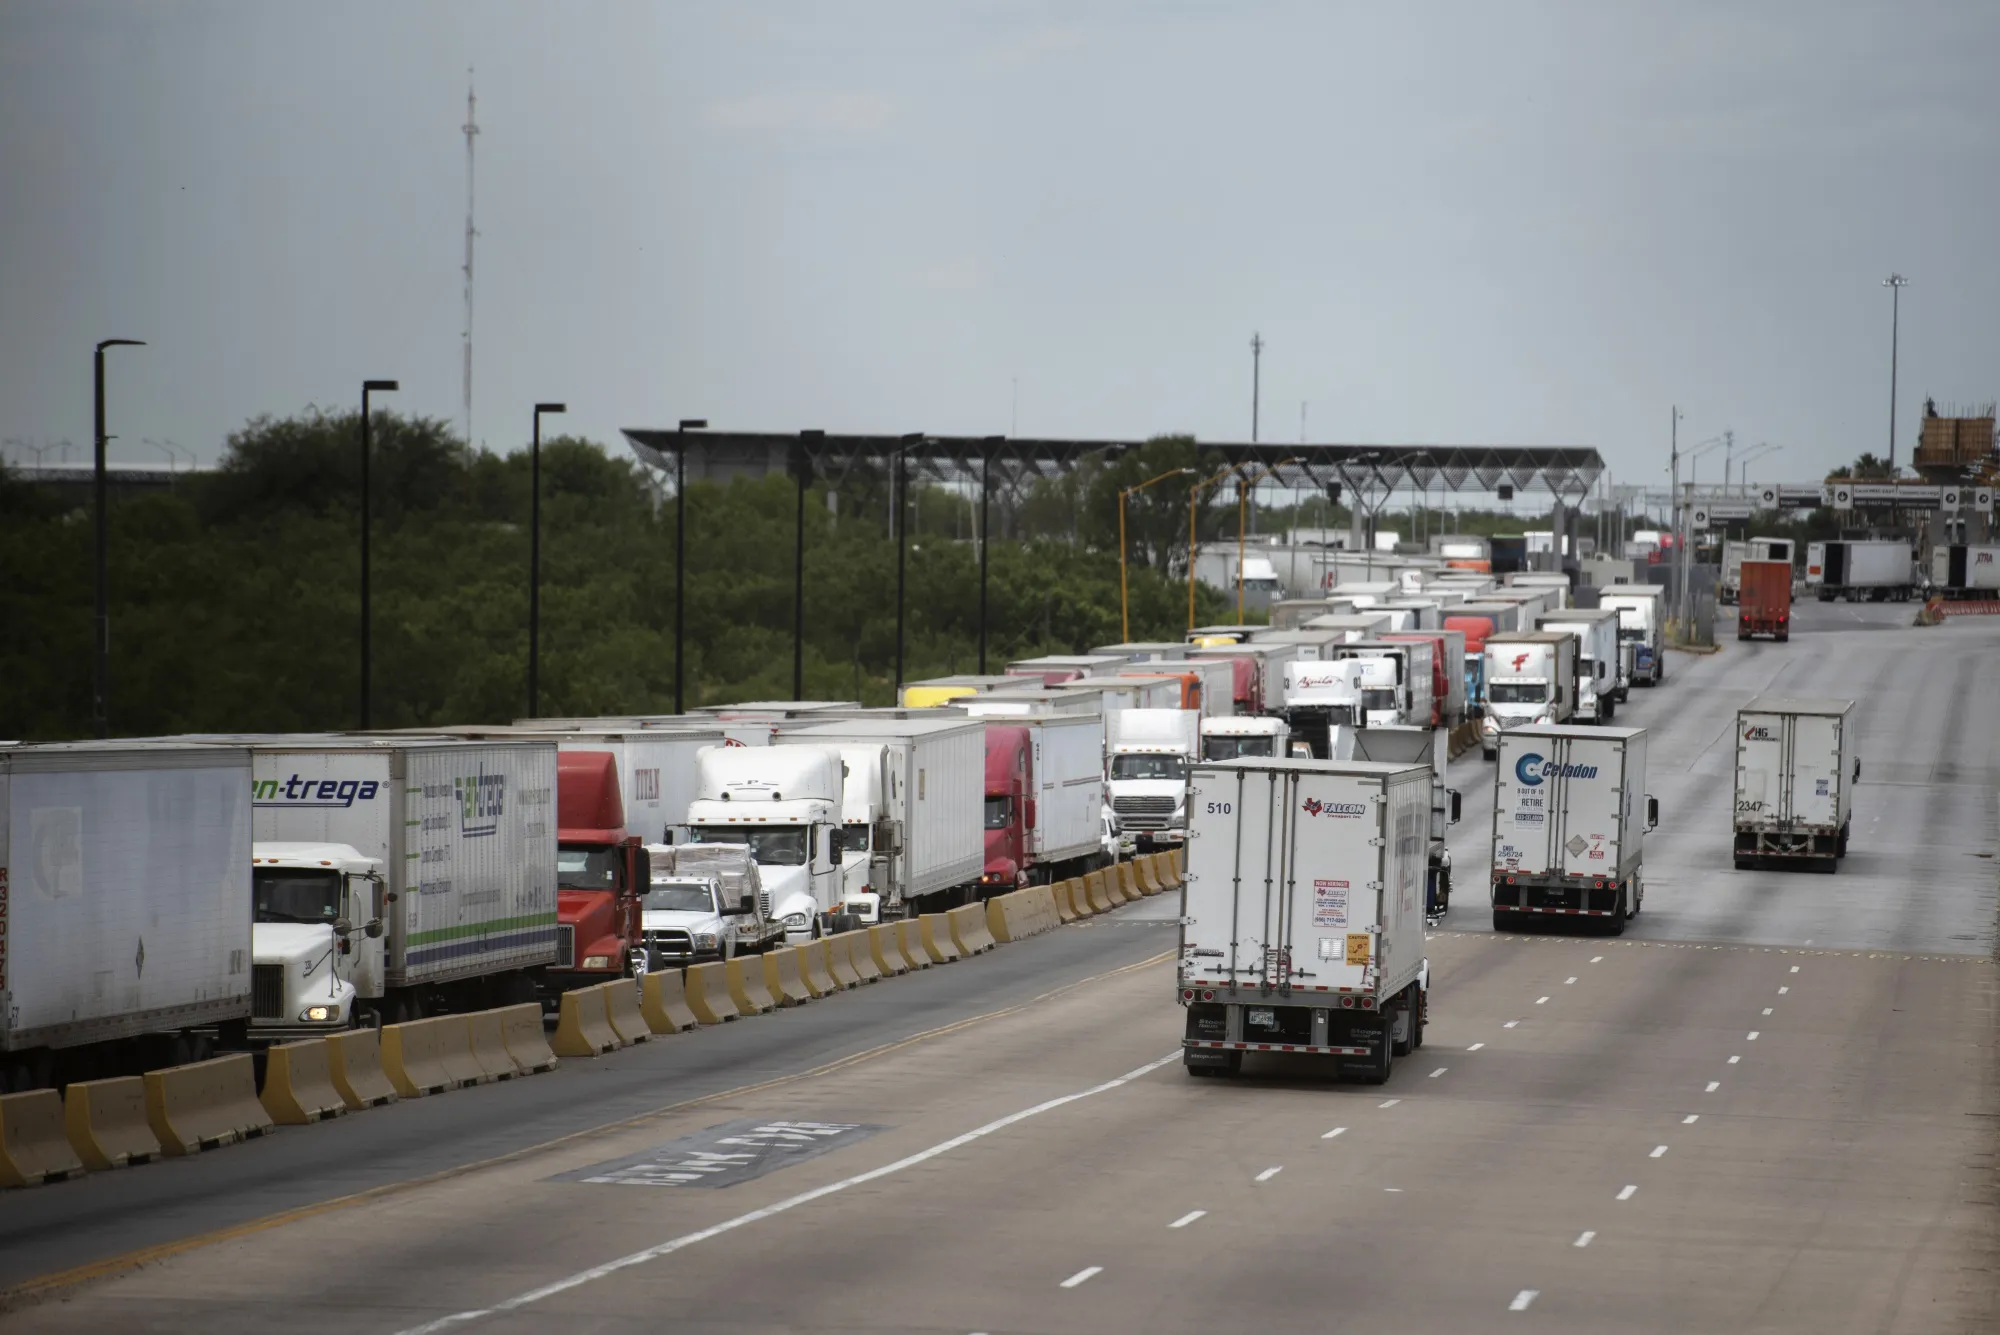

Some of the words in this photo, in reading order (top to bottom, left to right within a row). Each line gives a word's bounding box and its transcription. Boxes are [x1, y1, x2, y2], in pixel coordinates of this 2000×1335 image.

[1542, 761, 1598, 779] Celadon
[635, 768, 660, 800] TITAN
[1207, 802, 1232, 815] 510
[1323, 802, 1366, 815] FALCON
[1522, 798, 1544, 807] RETIRE
[1738, 800, 1763, 812] 2347
